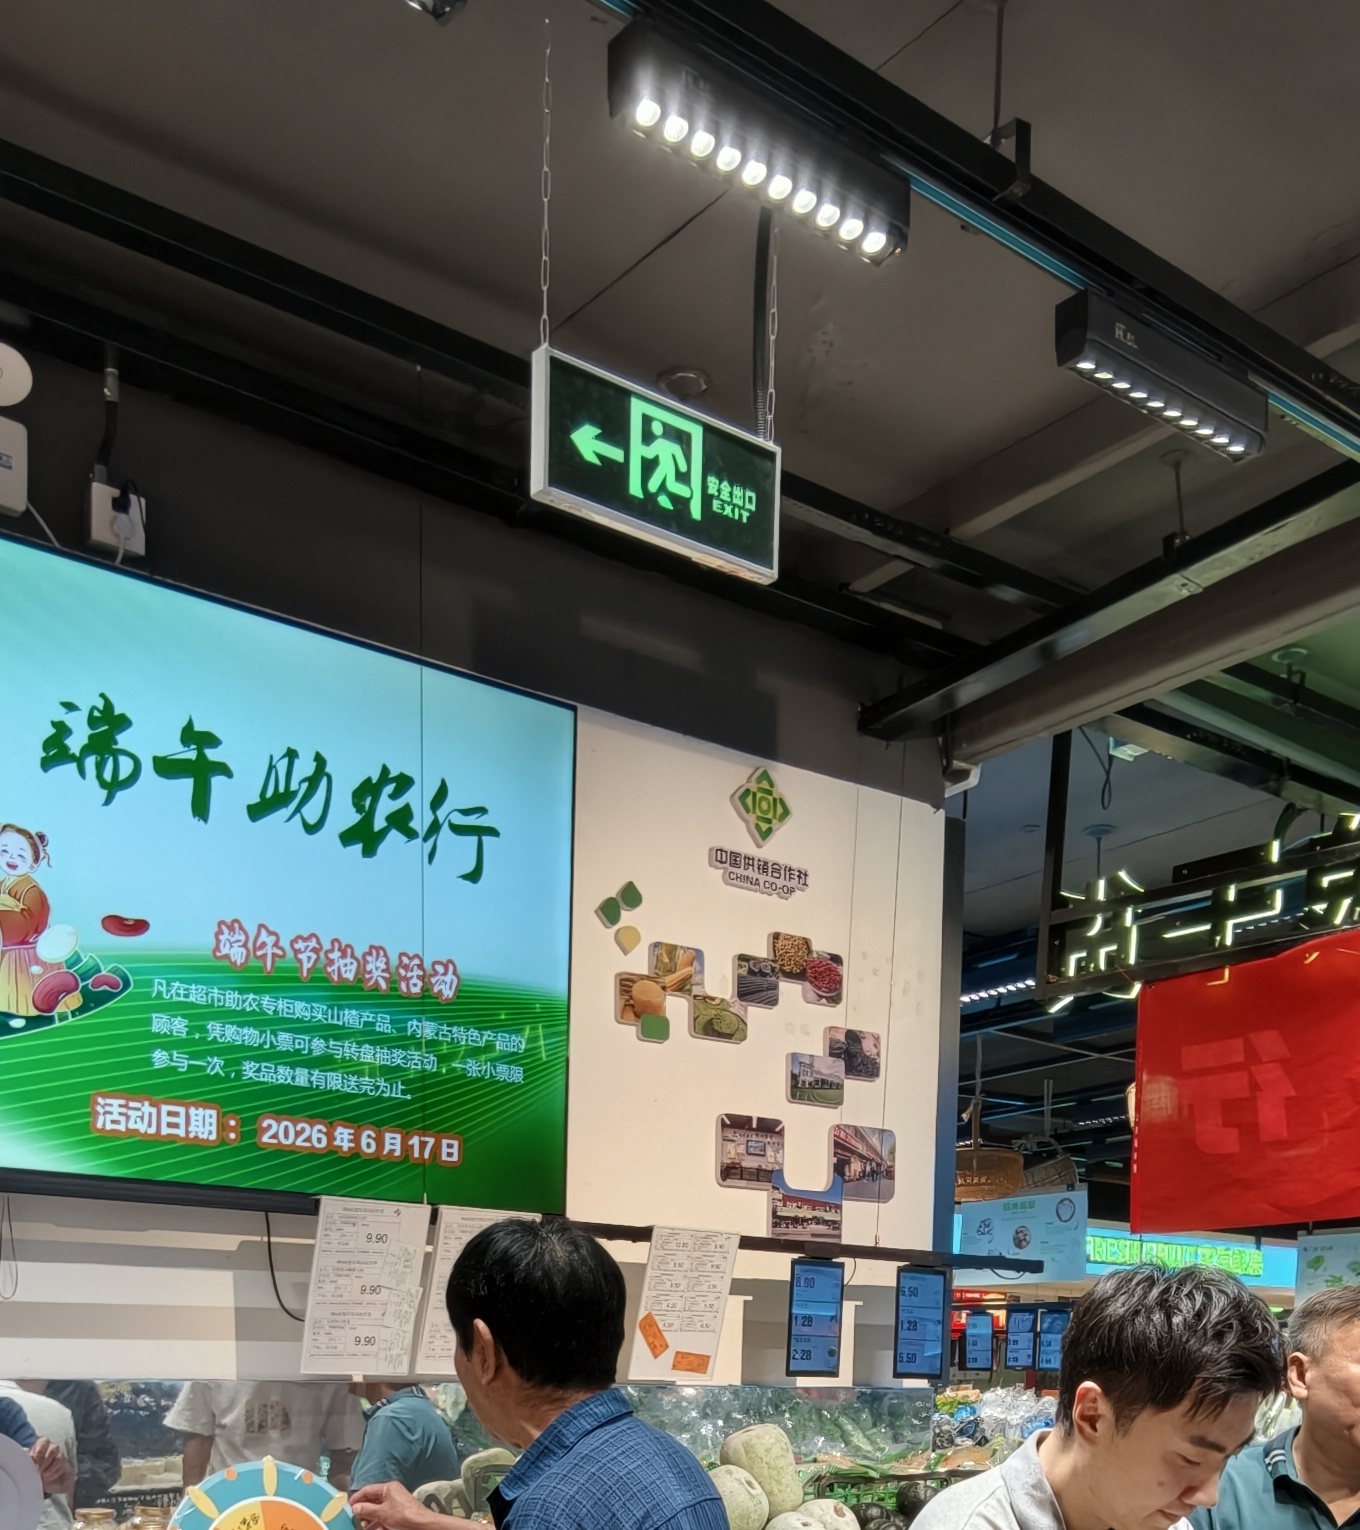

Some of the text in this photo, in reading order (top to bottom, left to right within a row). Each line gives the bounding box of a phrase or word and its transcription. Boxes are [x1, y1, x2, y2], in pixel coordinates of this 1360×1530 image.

[707, 475, 755, 511] 安全出口
[713, 499, 750, 523] EXIT
[40, 692, 500, 885] 端午助农行
[715, 848, 808, 888] 中国供销合作社
[728, 871, 796, 895] CHINA CO-OP
[215, 921, 460, 1000] 端午节抽奖活动
[366, 1233, 388, 1244] 9.90
[360, 1285, 382, 1295] 9.90
[354, 1336, 376, 1346] 9.90
